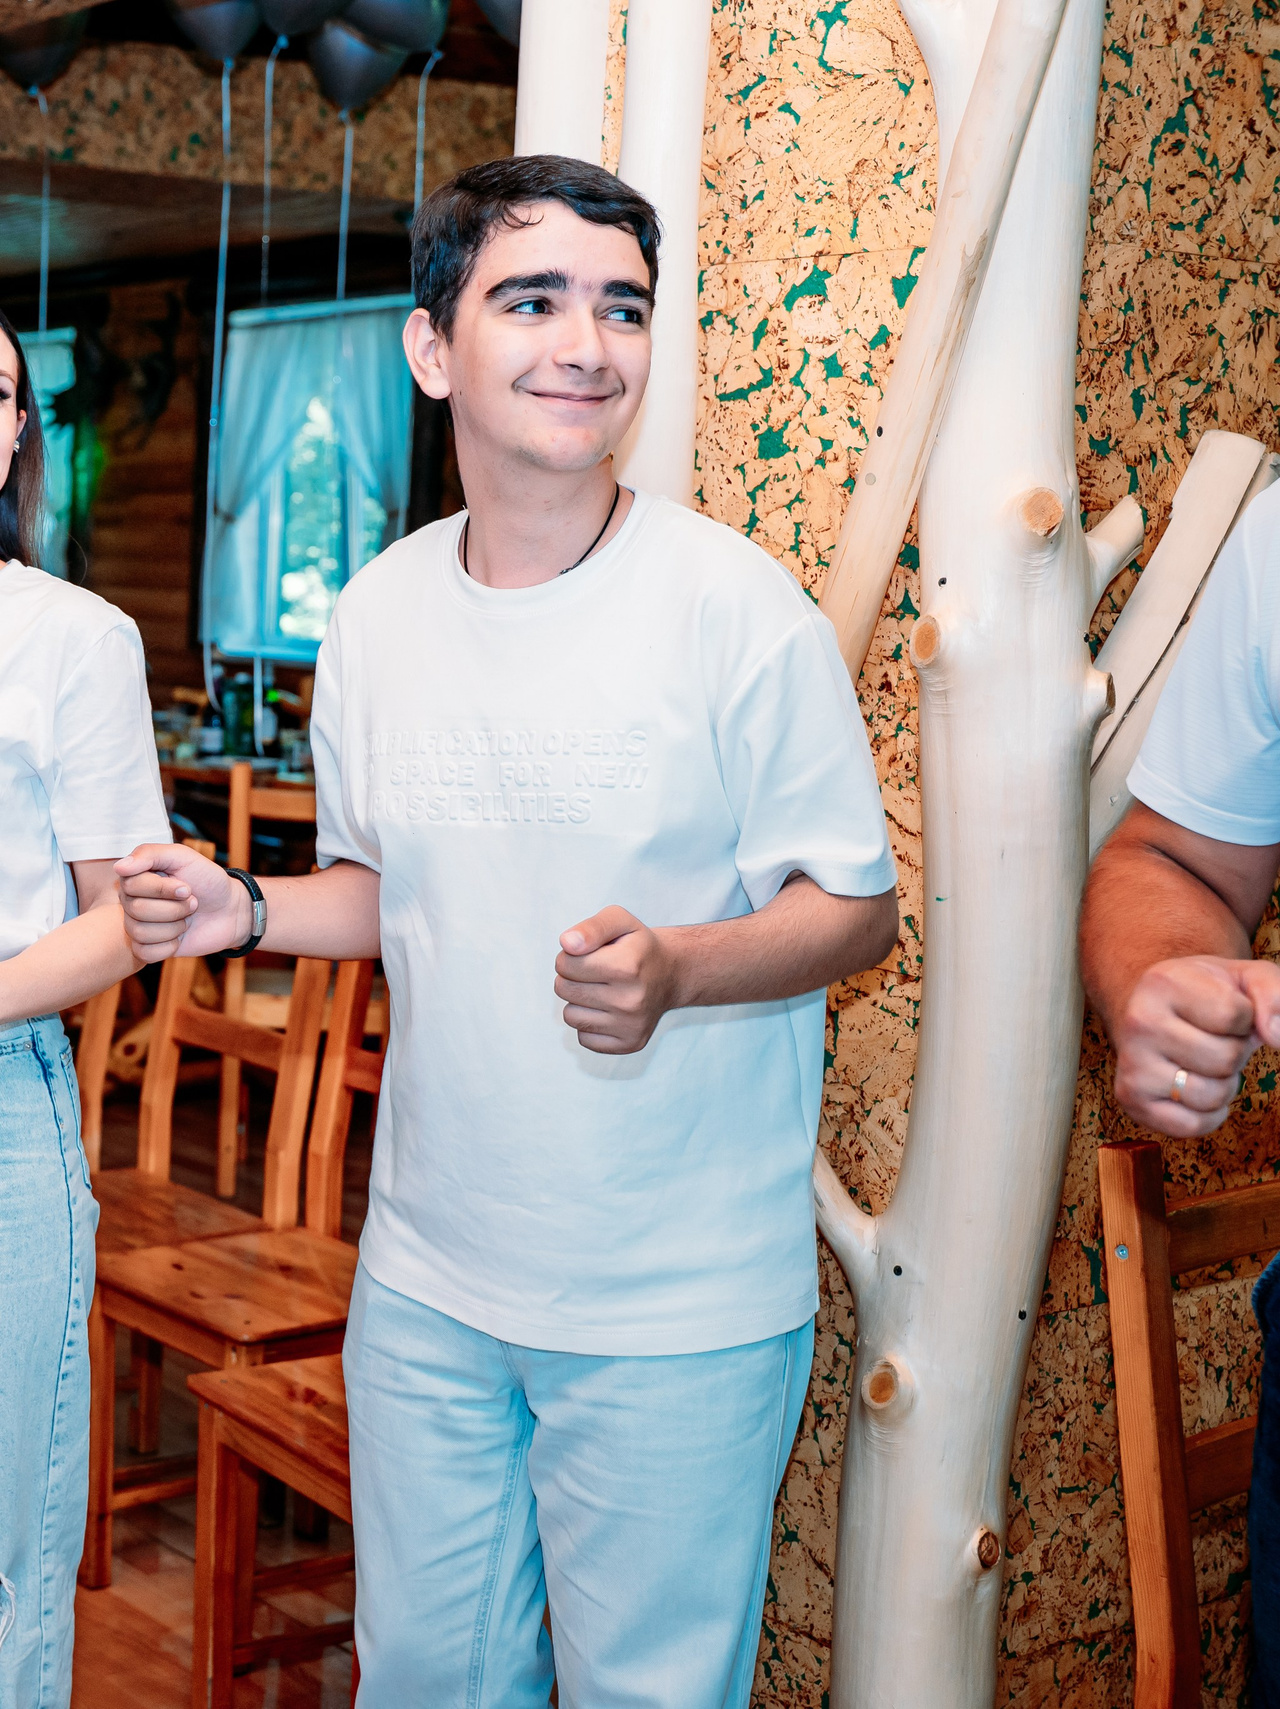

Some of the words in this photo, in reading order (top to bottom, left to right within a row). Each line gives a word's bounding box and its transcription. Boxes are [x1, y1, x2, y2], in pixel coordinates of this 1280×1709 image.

[543, 729, 648, 758] OPENS
[389, 760, 475, 786] SPACE
[498, 761, 552, 787] FOR
[574, 762, 649, 789] NEW
[370, 791, 593, 824] POSSIBILITIES
